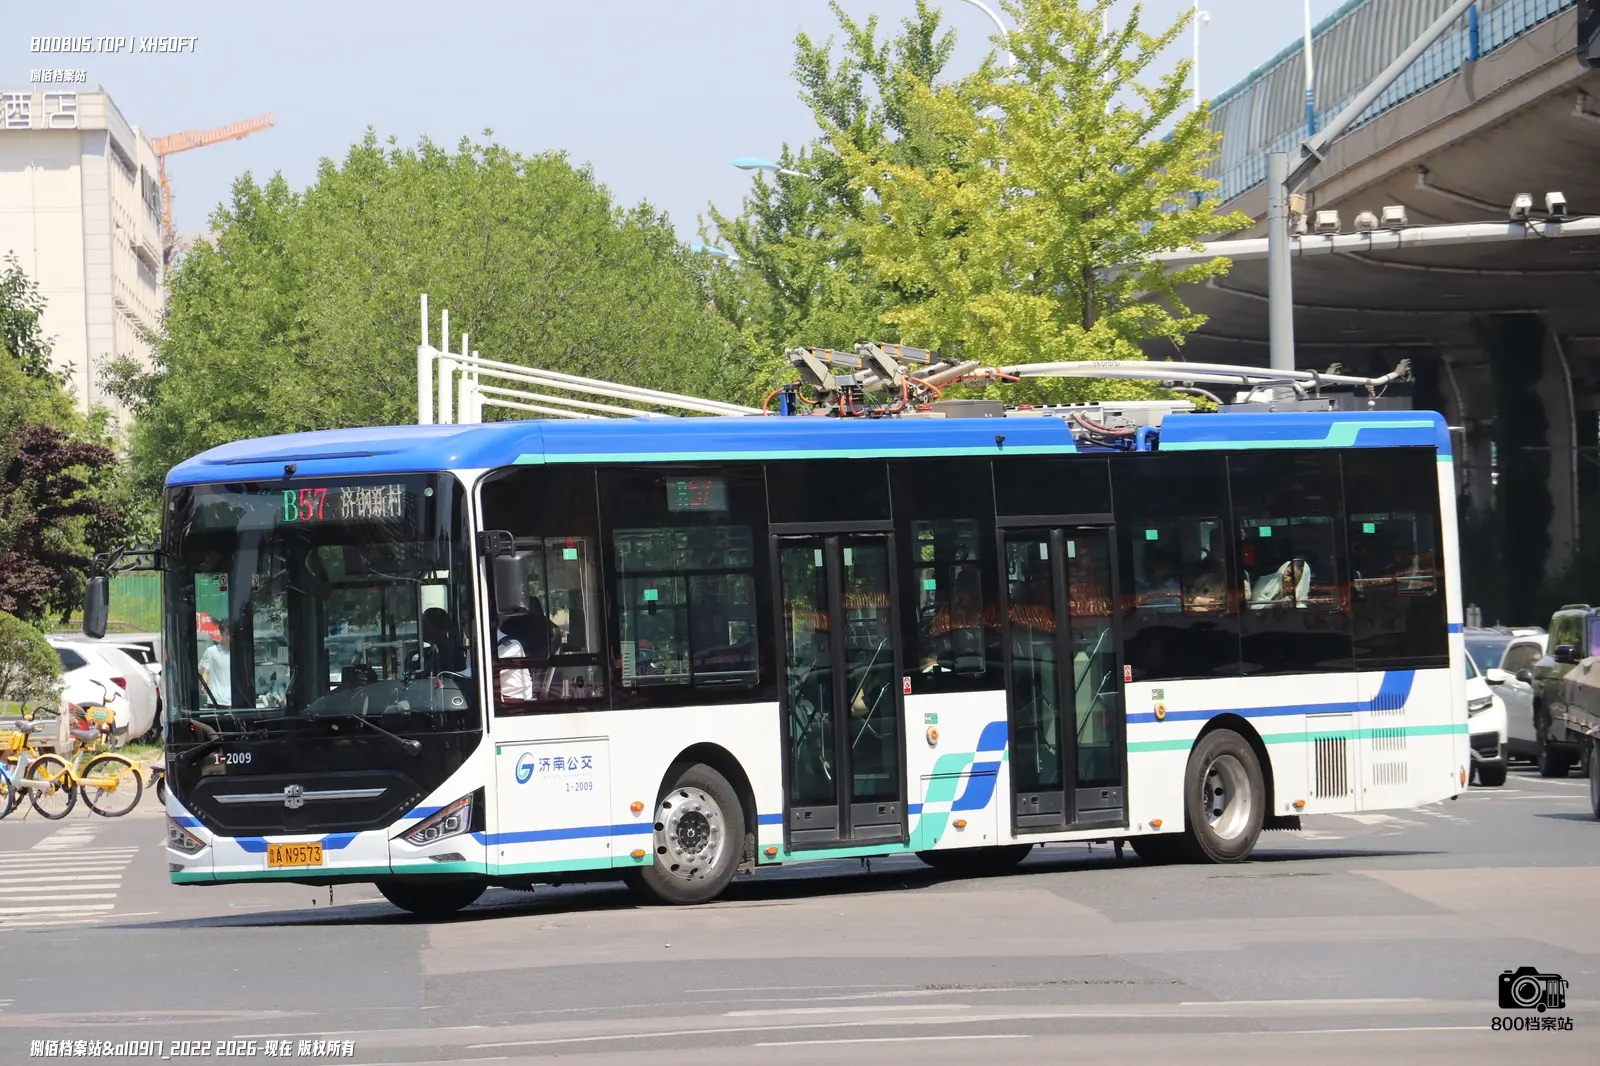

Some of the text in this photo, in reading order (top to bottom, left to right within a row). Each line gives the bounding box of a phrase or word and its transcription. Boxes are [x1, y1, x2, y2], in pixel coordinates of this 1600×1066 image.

[282, 488, 327, 521] B57
[214, 752, 252, 765] 1-2009
[539, 755, 592, 772] 济南公交
[566, 781, 593, 792] 1-2009
